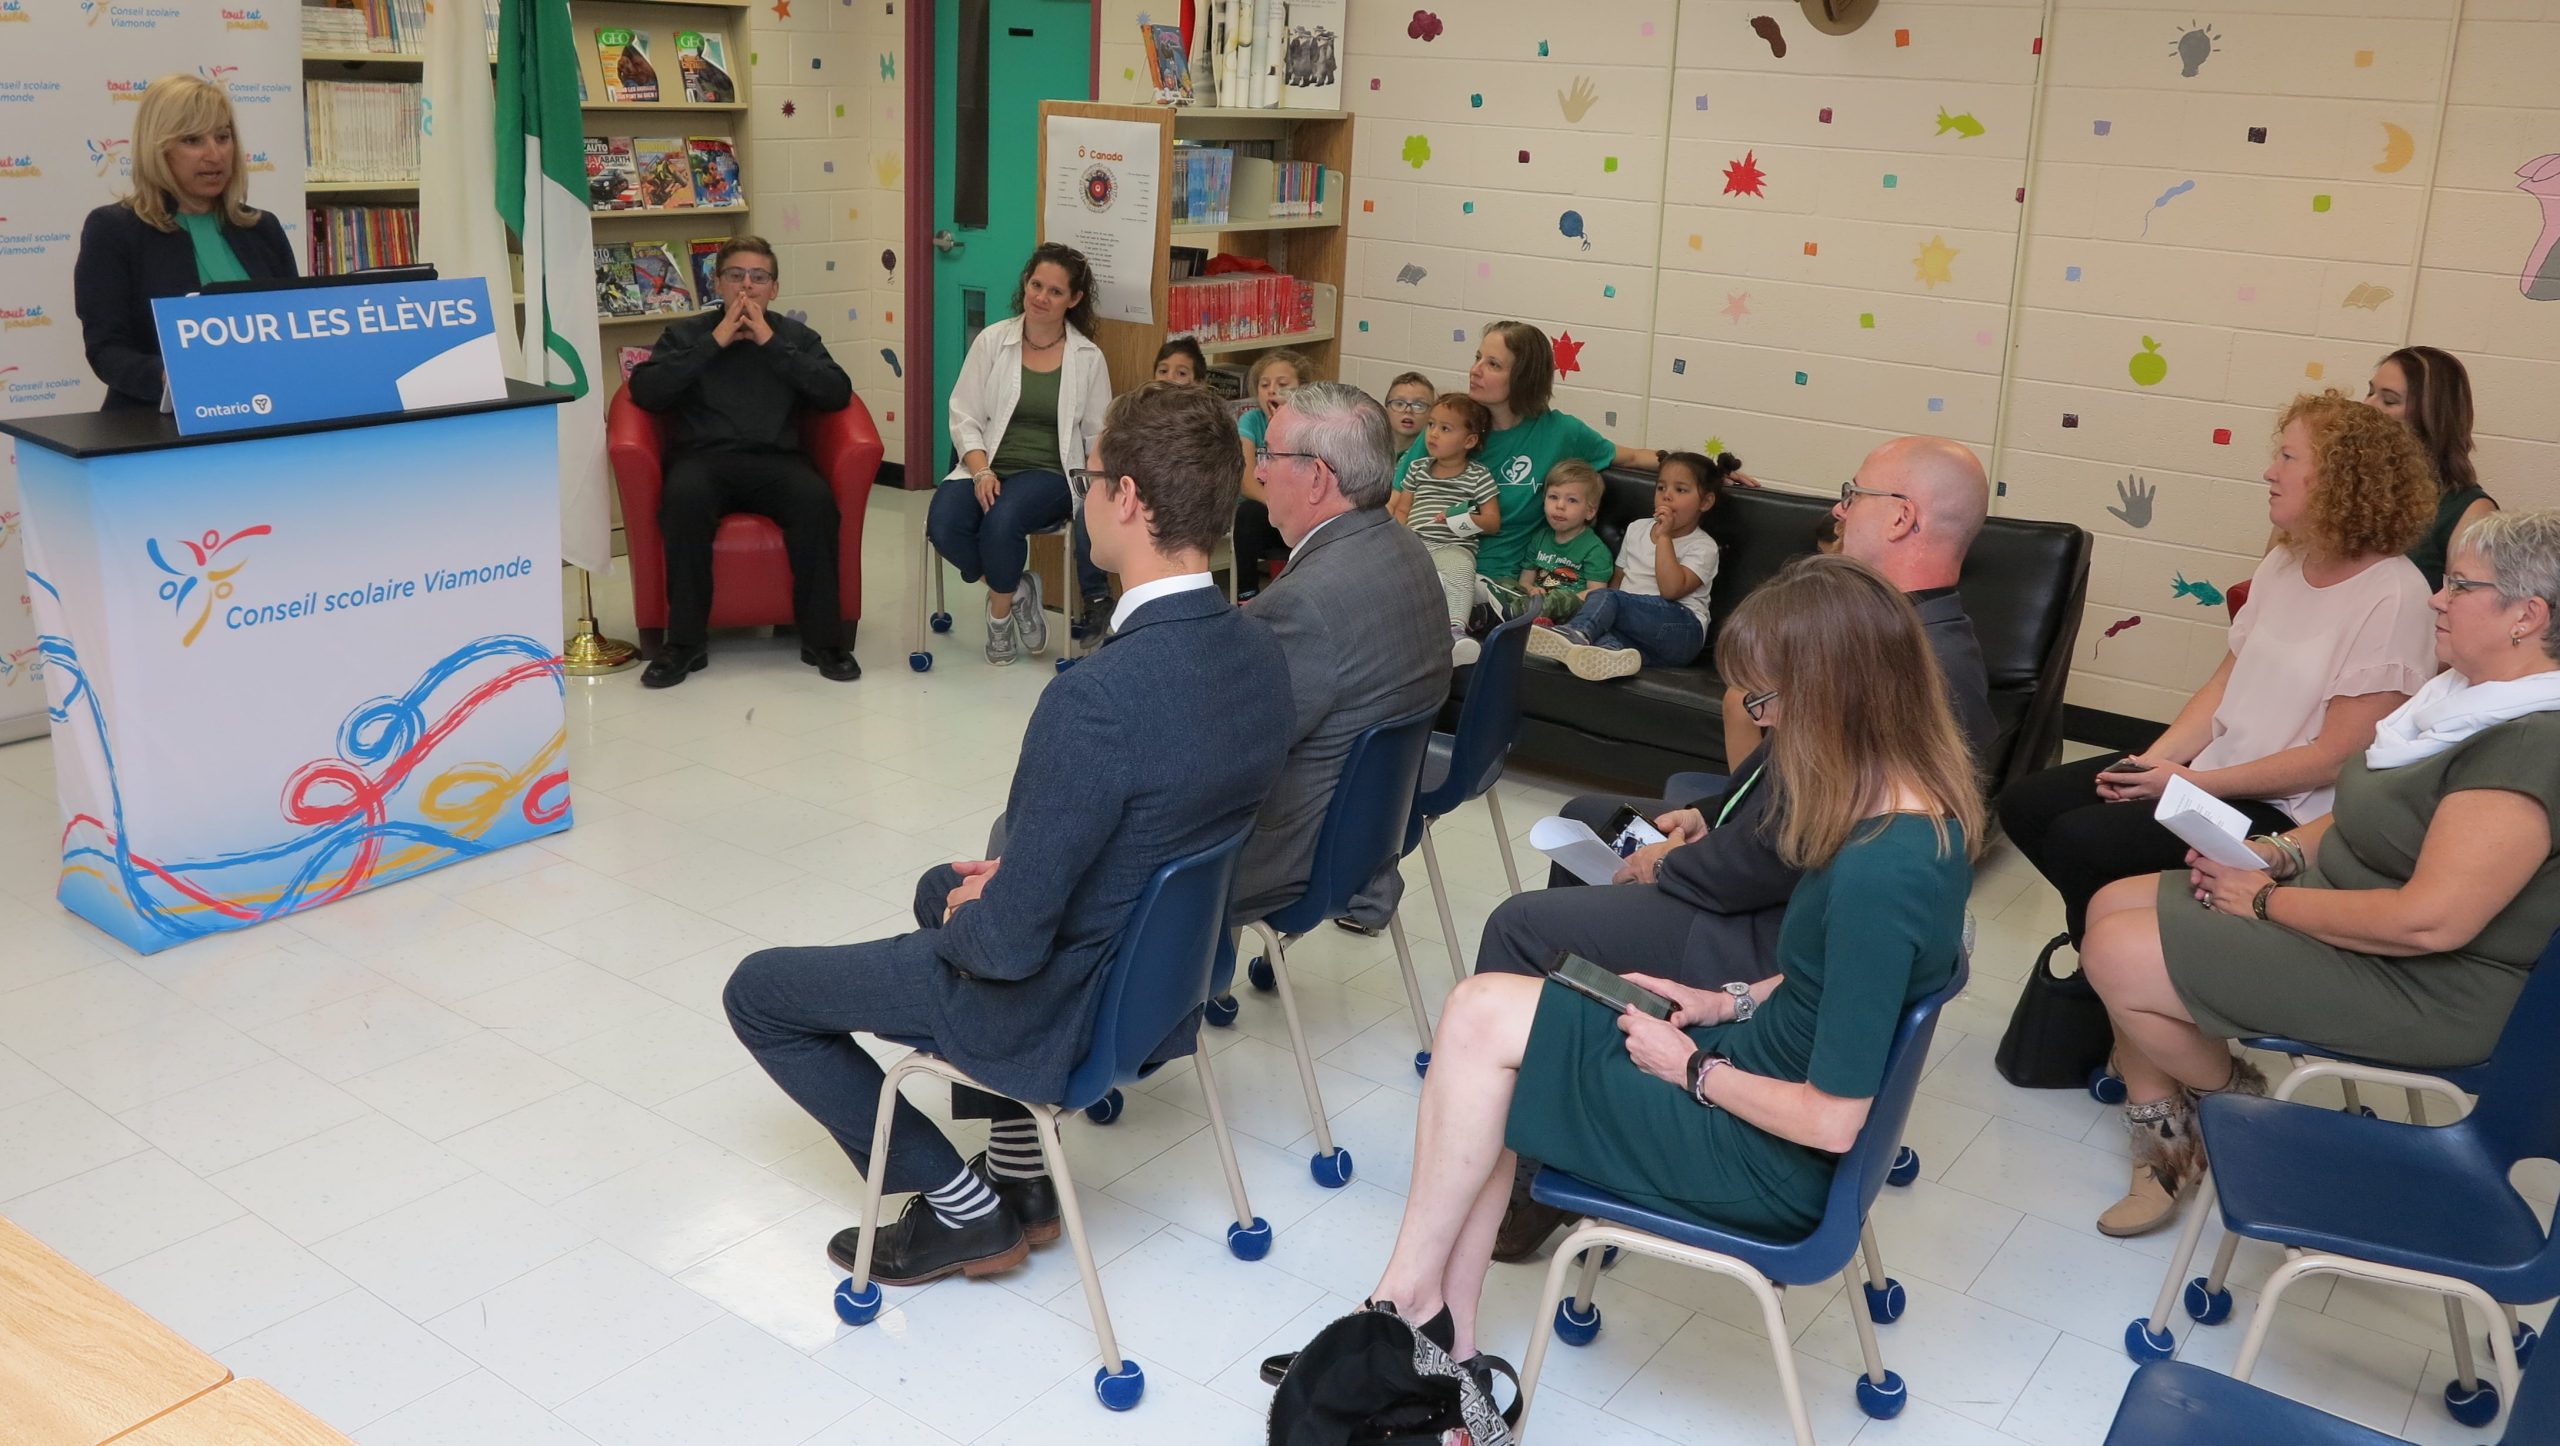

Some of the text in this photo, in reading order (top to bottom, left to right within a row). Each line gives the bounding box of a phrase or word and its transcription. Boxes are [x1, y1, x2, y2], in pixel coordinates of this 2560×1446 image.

[111, 6, 180, 17] Conseil scolaire
[222, 9, 261, 19] tout est
[111, 18, 156, 28] Viamonde
[23, 82, 60, 91] scolaire
[107, 80, 131, 91] tout
[228, 83, 292, 92] Conseil scolaire
[15, 155, 32, 167] est
[1090, 150, 1123, 162] Canada
[35, 232, 71, 242] scolaire
[26, 305, 43, 317] est
[176, 296, 478, 349] POUR LES ÉLÈVES
[8, 377, 81, 392] Conseil scolaire
[9, 391, 57, 403] Viamonde
[195, 400, 250, 418] Ontario
[226, 555, 533, 630] Conseil scolaire Viamonde
